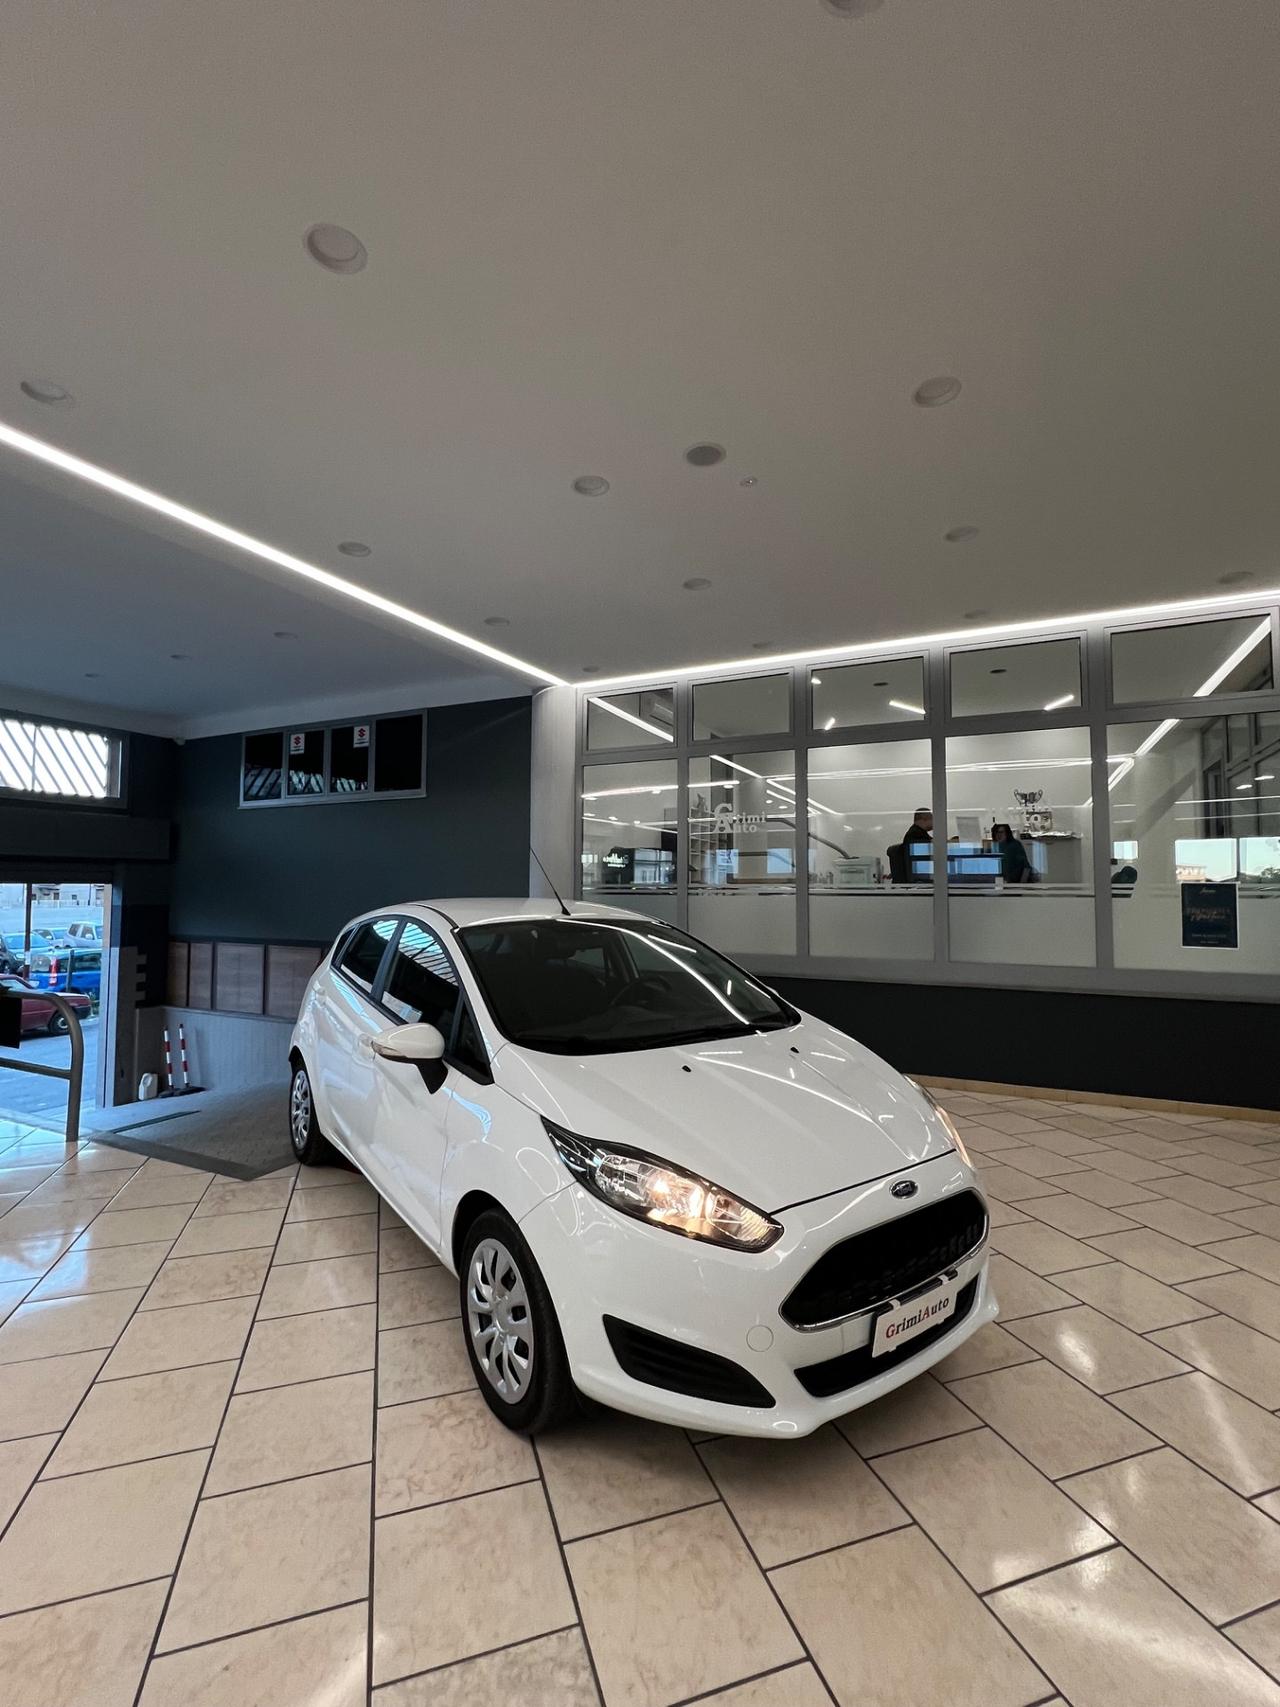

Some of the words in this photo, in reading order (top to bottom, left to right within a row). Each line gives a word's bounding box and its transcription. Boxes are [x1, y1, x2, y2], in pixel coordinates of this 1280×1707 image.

[713, 813, 758, 833] Auto
[714, 803, 767, 823] Grimi
[885, 1297, 949, 1339] GrimiAuto
